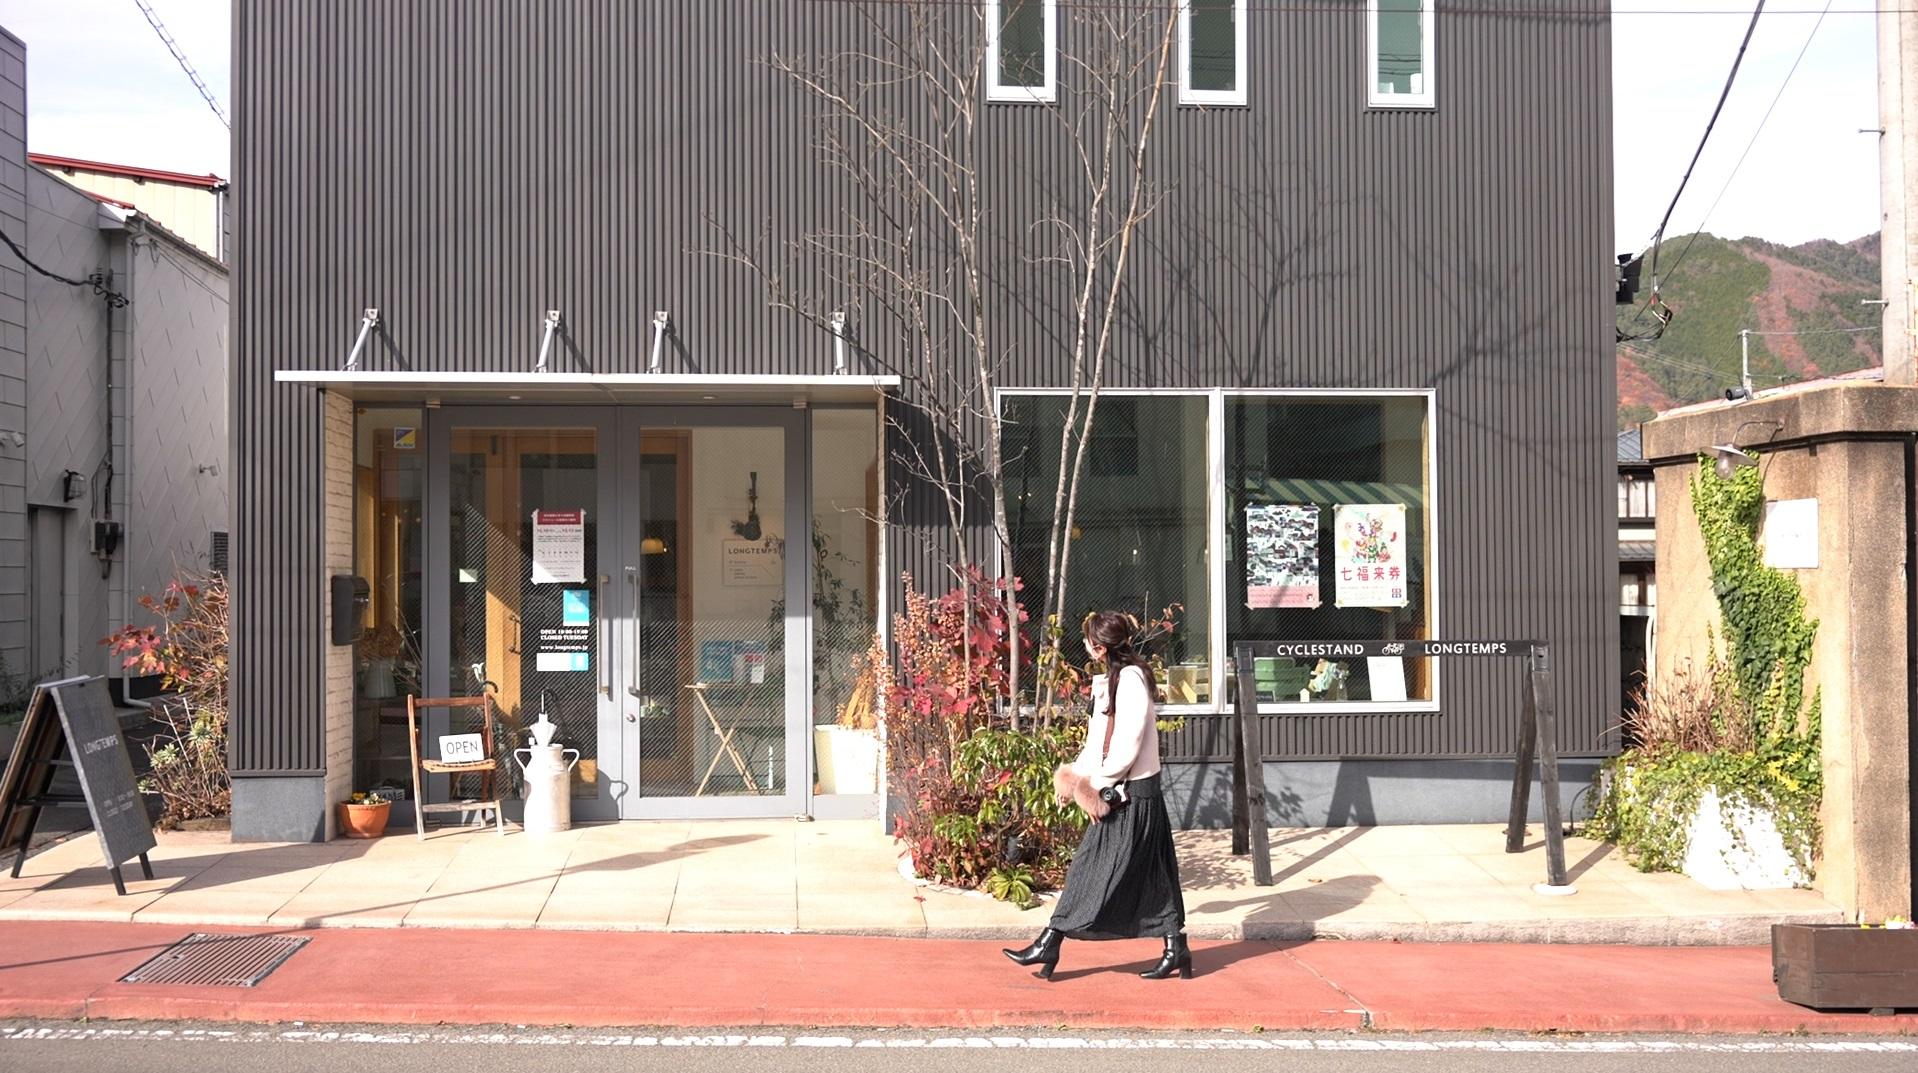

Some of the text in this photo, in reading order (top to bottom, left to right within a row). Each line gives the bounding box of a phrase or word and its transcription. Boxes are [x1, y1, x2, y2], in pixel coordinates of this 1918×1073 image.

[1277, 642, 1507, 656] CYCLESTAND LONGTEMPS
[446, 740, 479, 755] OPEN
